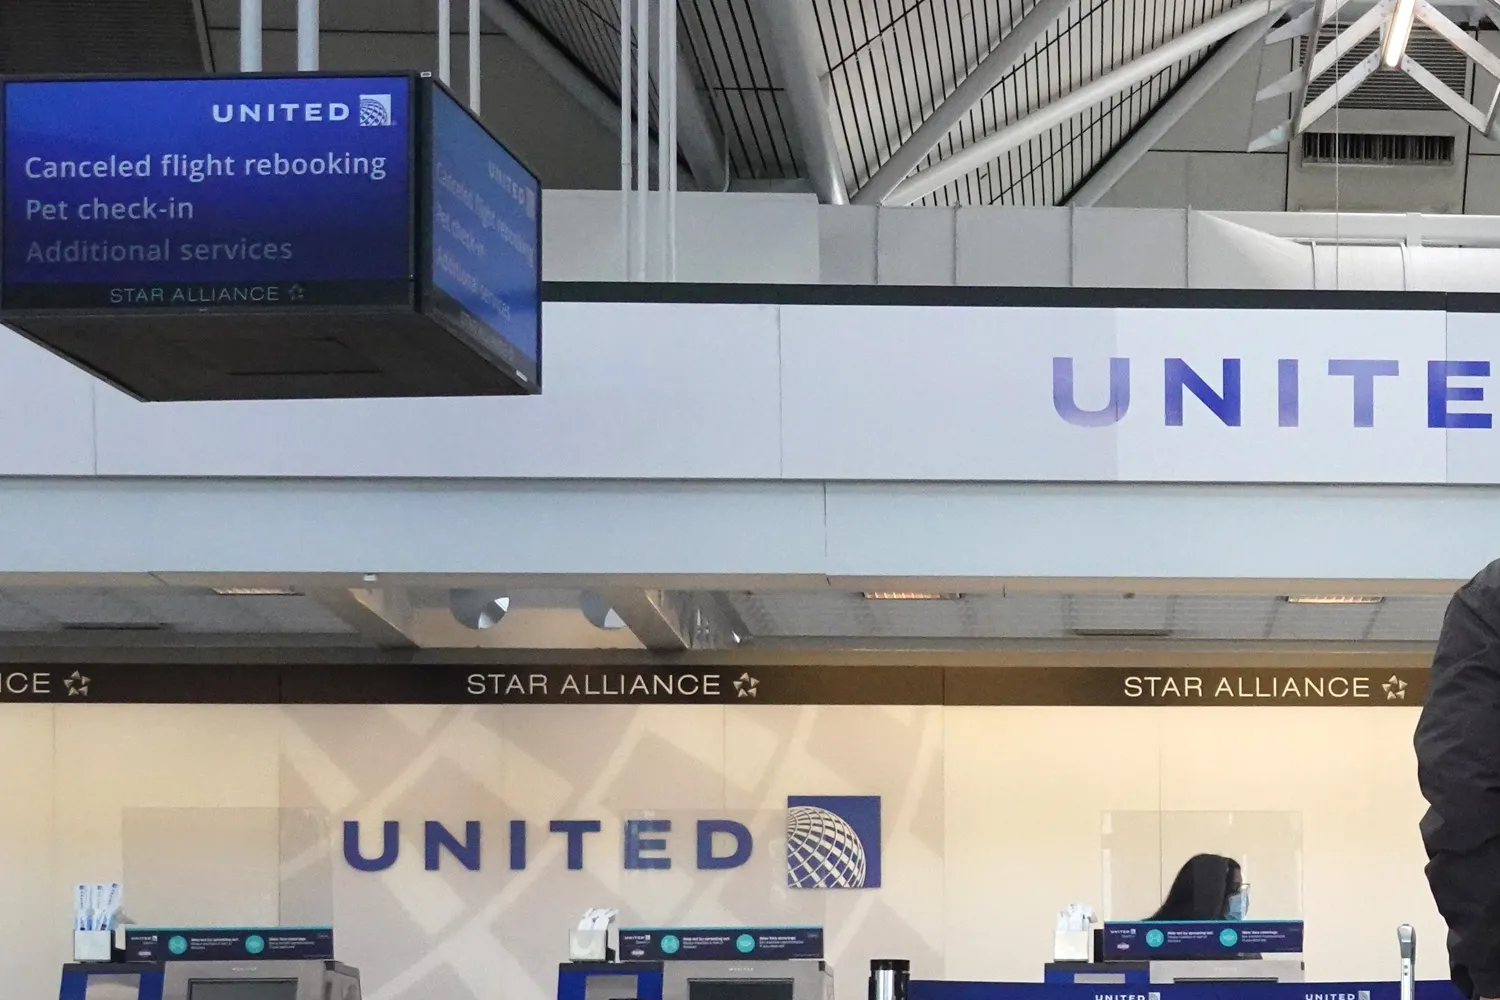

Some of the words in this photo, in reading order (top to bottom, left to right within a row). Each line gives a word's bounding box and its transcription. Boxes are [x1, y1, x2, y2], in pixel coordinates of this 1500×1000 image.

[212, 102, 350, 123] UNITED
[25, 154, 151, 179] Canceled
[161, 154, 235, 182] flight
[244, 152, 387, 181] rebooking
[26, 198, 68, 221] Pet
[78, 197, 194, 220] check-in
[26, 238, 170, 263] Additional
[180, 237, 293, 261] services
[110, 287, 164, 304] STAR
[172, 286, 280, 302] ALLIANCE
[466, 673, 549, 697] STAR
[560, 673, 722, 697] ALLIANCE
[1123, 676, 1203, 698] STAR
[1214, 676, 1370, 698] ALLIANCE
[342, 819, 755, 872] UNITED
[1305, 993, 1356, 1000] UNITED
